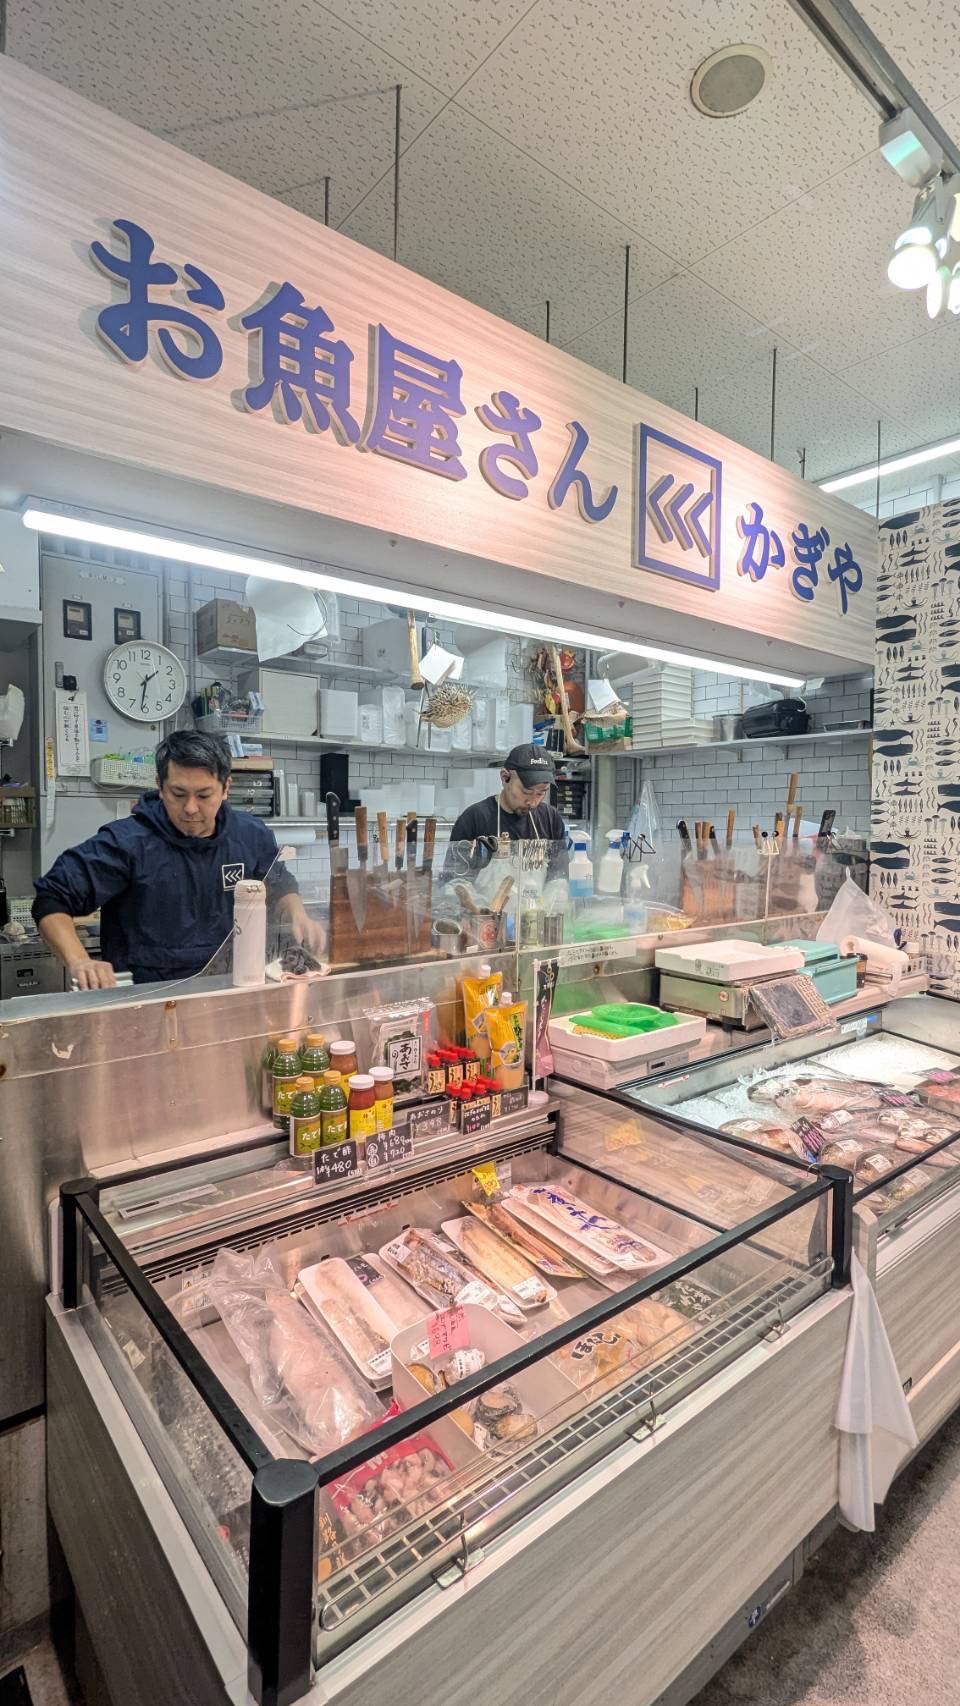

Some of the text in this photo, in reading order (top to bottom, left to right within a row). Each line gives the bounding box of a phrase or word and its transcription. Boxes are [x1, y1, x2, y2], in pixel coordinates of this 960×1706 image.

[90, 218, 619, 524] お魚屋さん
[736, 502, 864, 616] かぎや
[128, 651, 136, 662] 11
[140, 649, 151, 661] 12
[116, 659, 128, 671] 10
[166, 665, 173, 676] 2
[112, 672, 121, 684] 9
[168, 679, 176, 690] 3
[117, 687, 125, 698] 8
[165, 693, 172, 703] 4
[129, 698, 136, 709] 7
[142, 703, 150, 714] 6
[155, 701, 163, 712] 5
[399, 1042, 412, 1070] あおさ
[410, 1105, 444, 1121] あおさのり
[321, 1145, 352, 1163] たで酢
